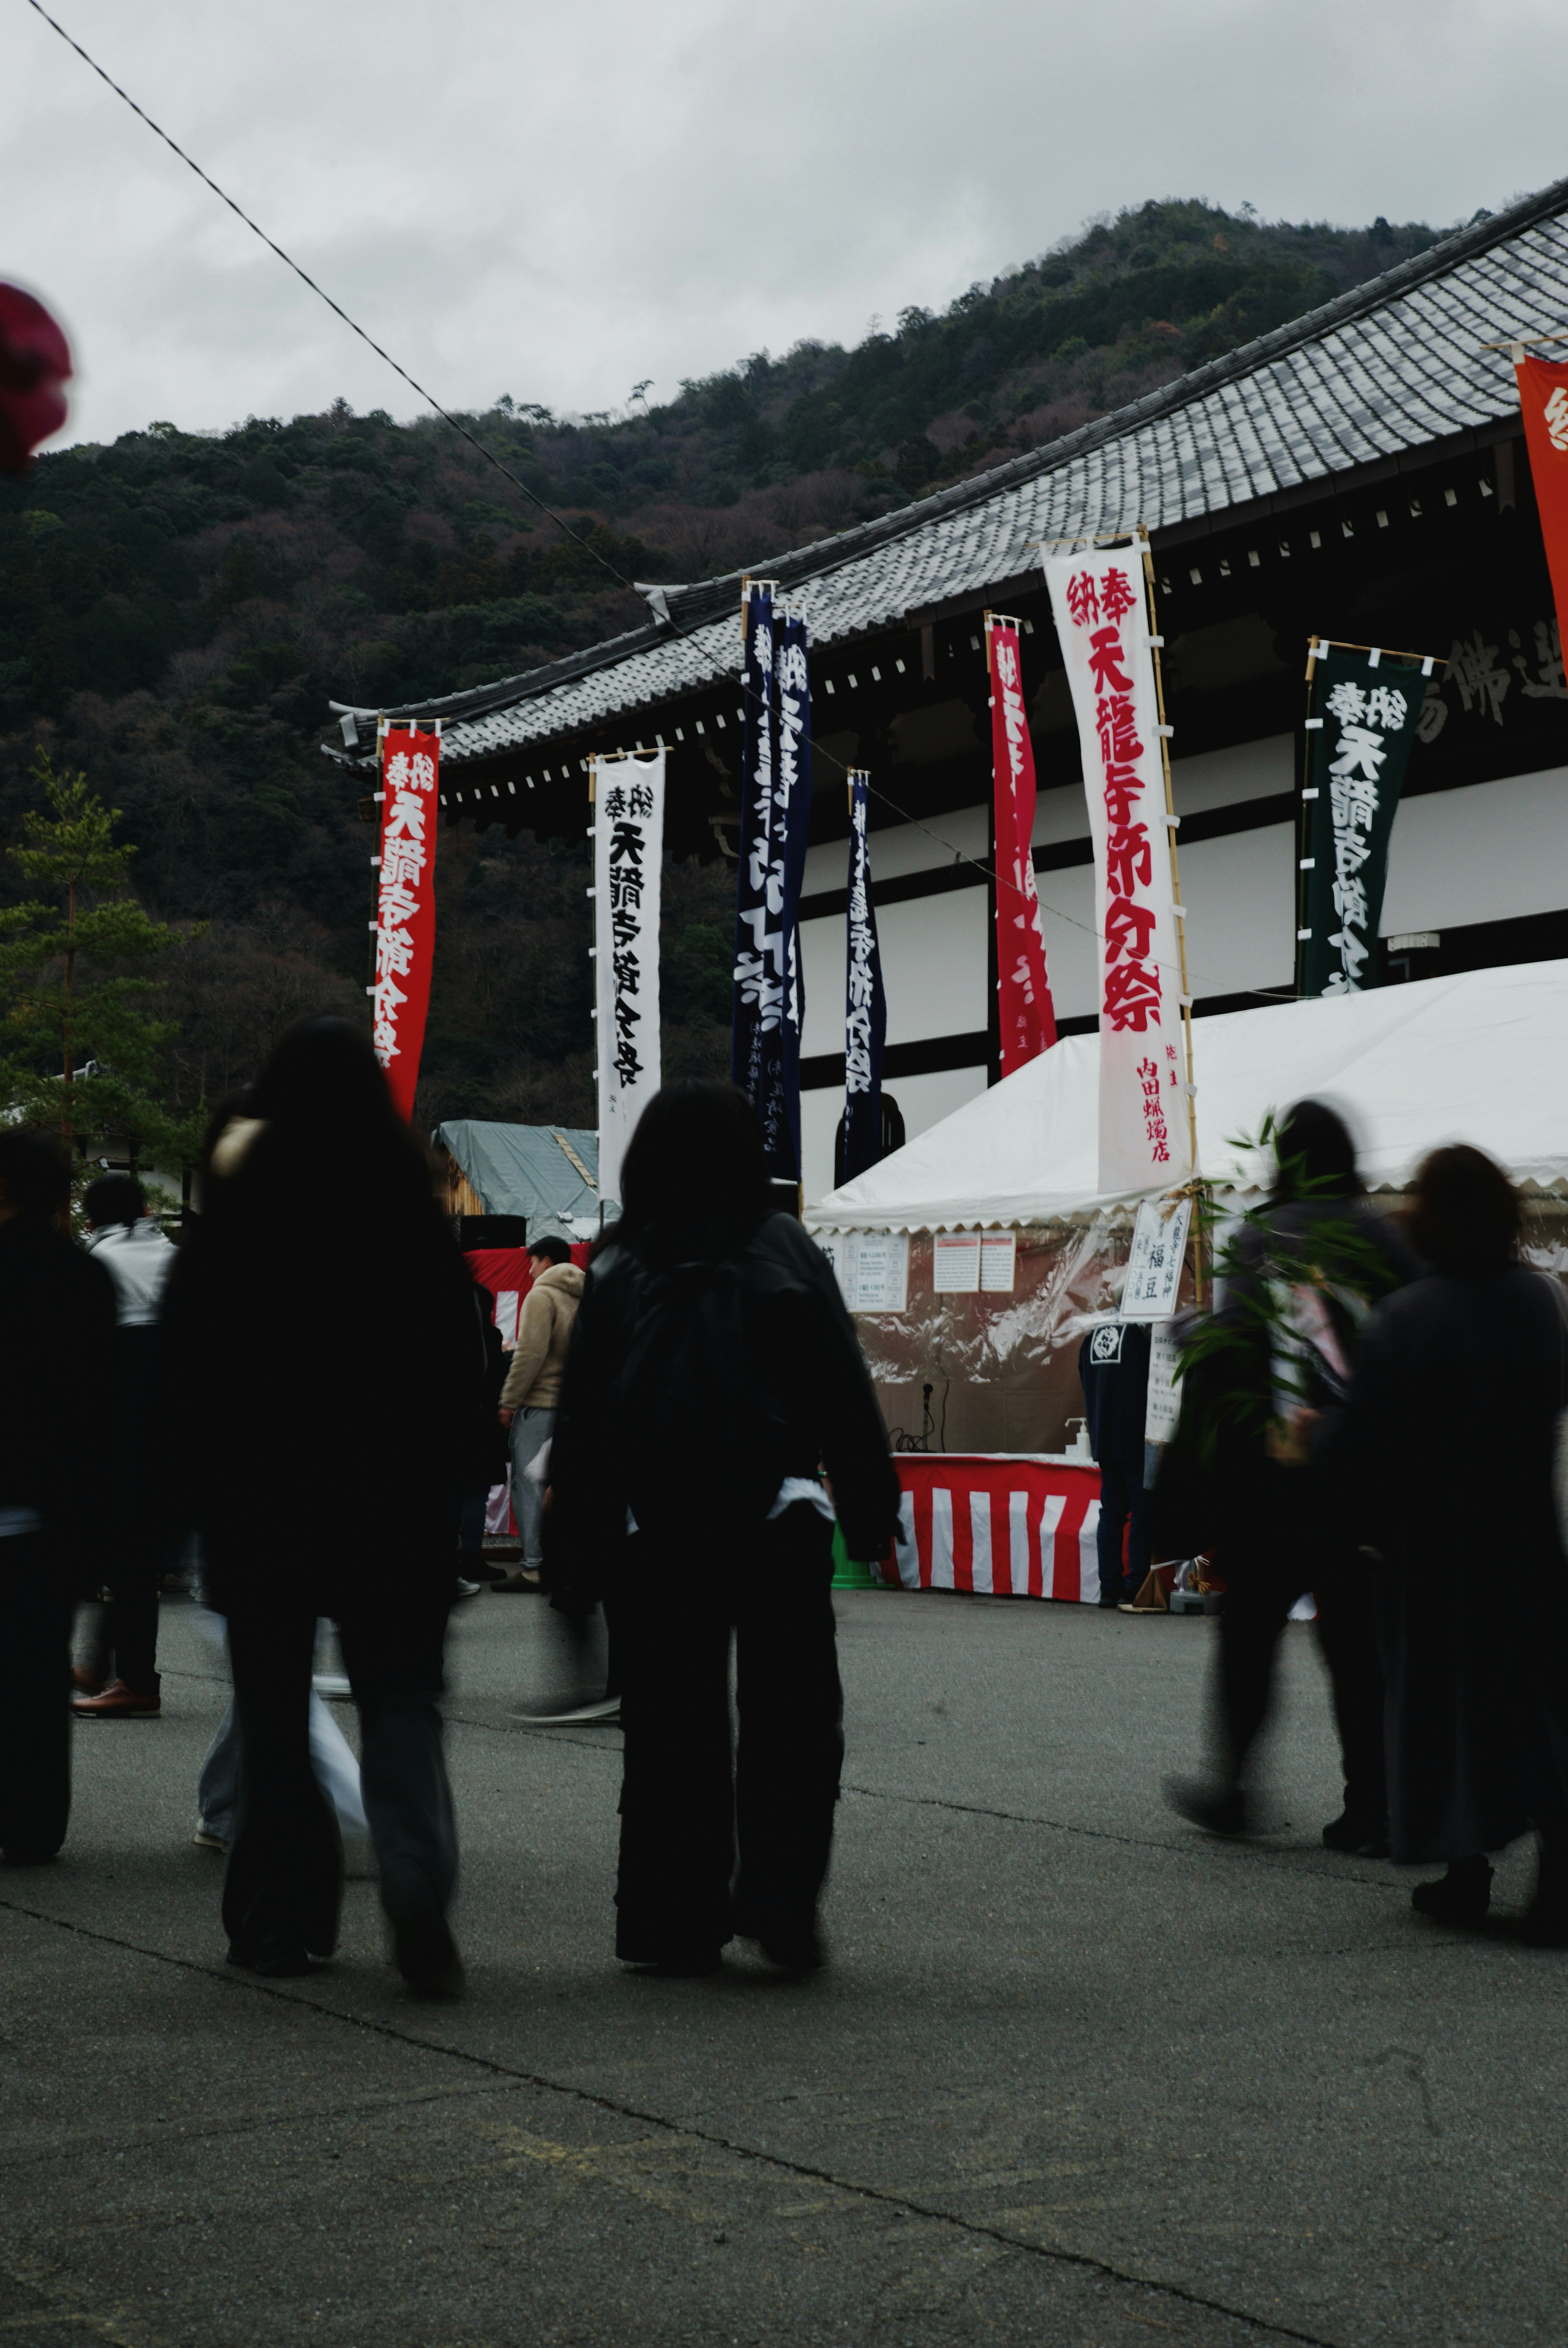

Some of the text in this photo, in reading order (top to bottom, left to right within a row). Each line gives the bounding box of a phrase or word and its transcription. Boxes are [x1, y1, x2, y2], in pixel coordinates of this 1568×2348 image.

[1086, 626, 1163, 1032] 天龍寺節分祭
[1142, 1243, 1165, 1300] 福豆
